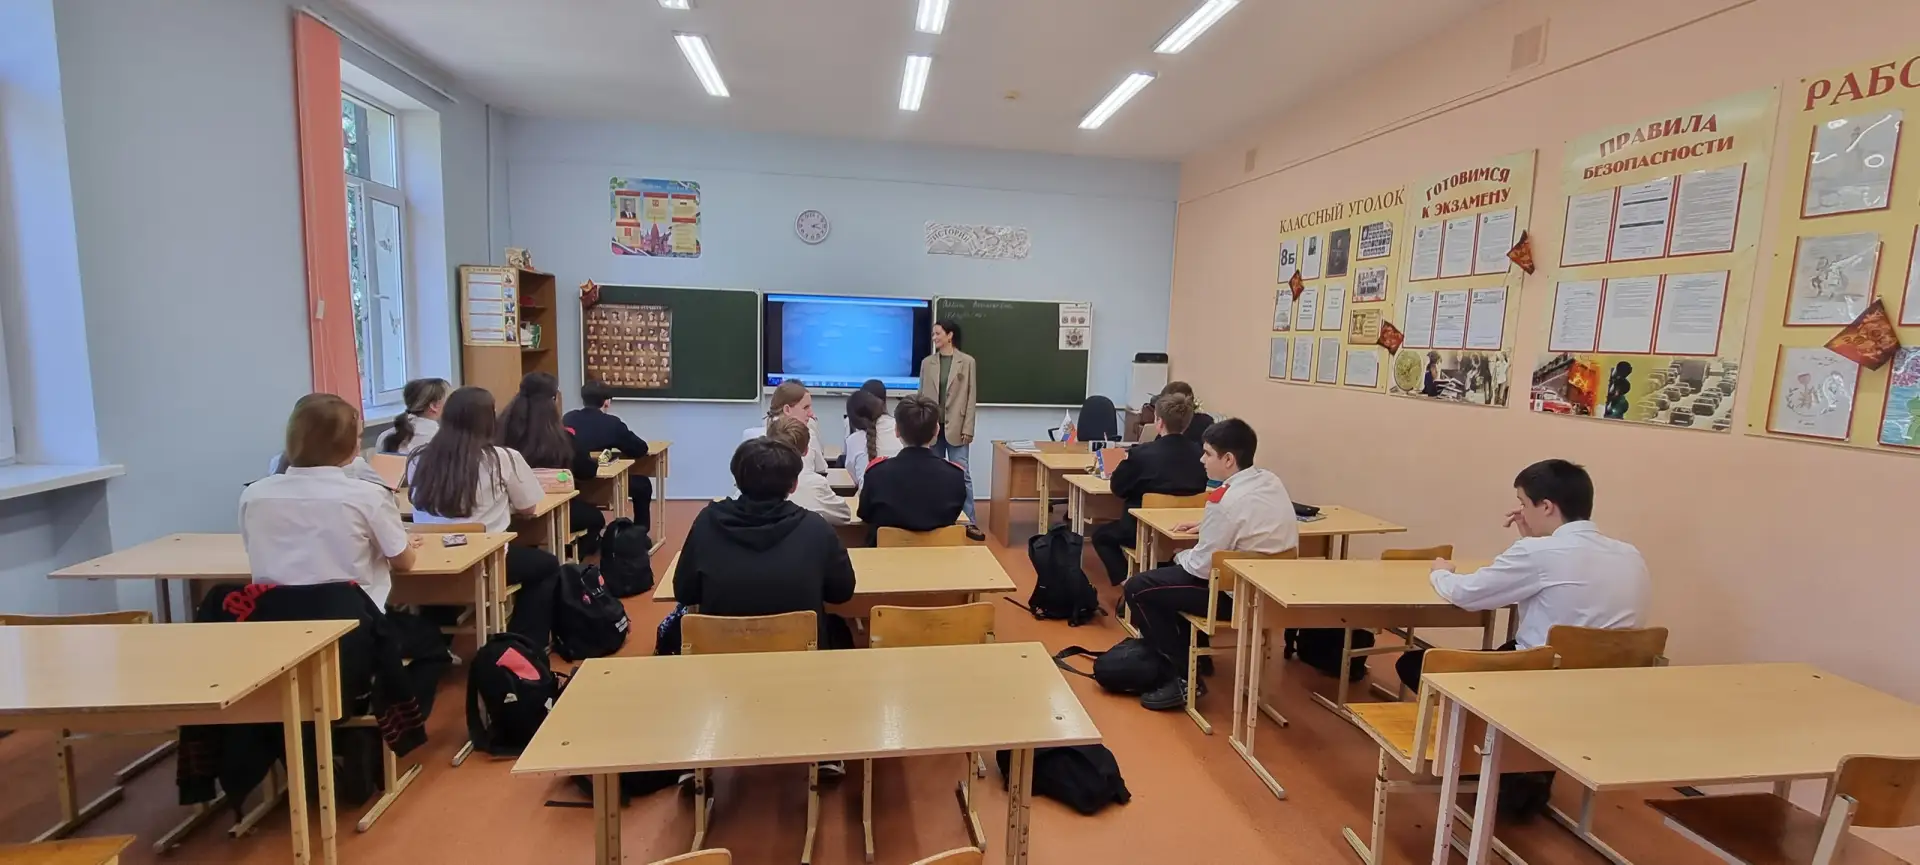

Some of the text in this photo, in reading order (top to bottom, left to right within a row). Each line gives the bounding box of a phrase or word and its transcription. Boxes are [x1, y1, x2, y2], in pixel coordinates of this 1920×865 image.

[1583, 136, 1734, 180] БЕЗОПАСНОСТИ
[1600, 114, 1717, 158] ПРАВИЛА
[1422, 187, 1511, 219] К ЭКЗАМЕНУ
[1426, 166, 1511, 201] ГОТОВИМСЯ
[1280, 187, 1405, 234] КЛАССНЫЙ УГОЛОК
